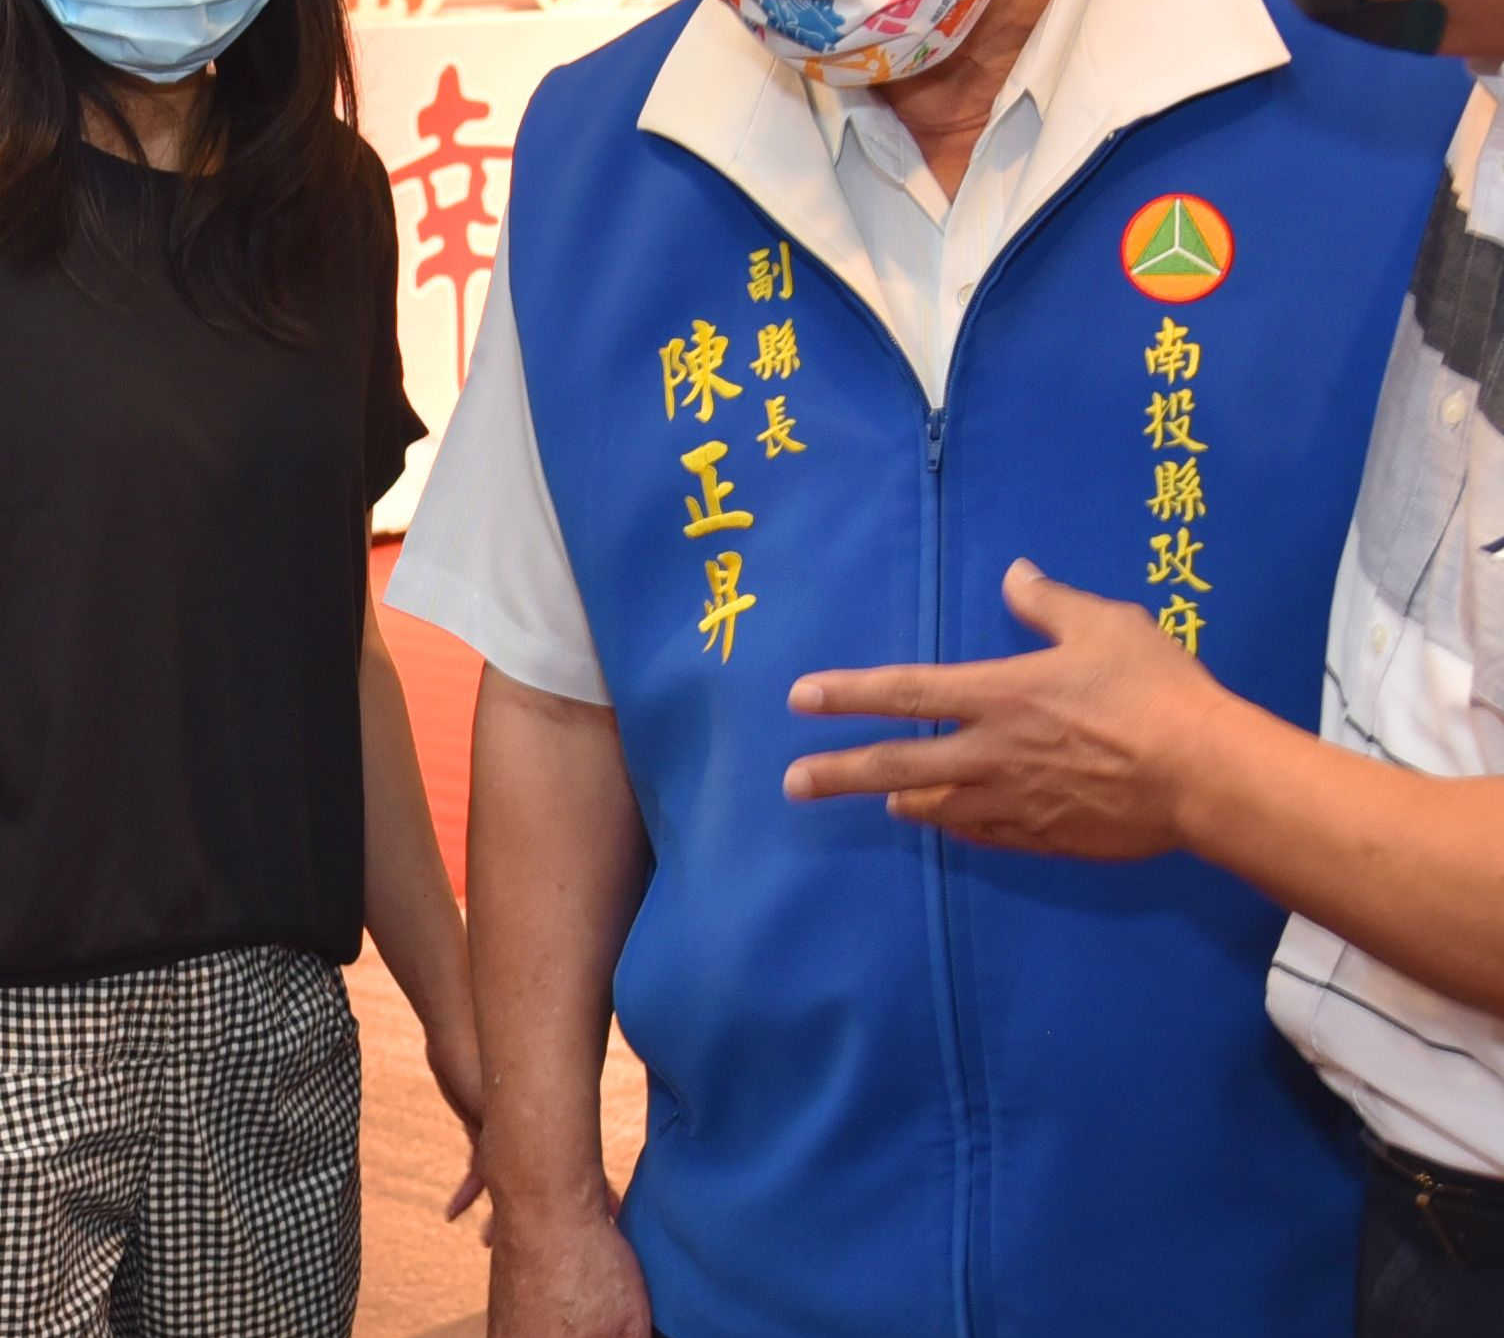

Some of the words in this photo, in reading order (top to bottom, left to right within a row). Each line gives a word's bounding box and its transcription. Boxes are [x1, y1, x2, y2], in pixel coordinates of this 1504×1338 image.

[658, 319, 757, 665] 陳正昇
[747, 241, 808, 460] 副縣長
[1142, 317, 1214, 657] 南投縣政府
